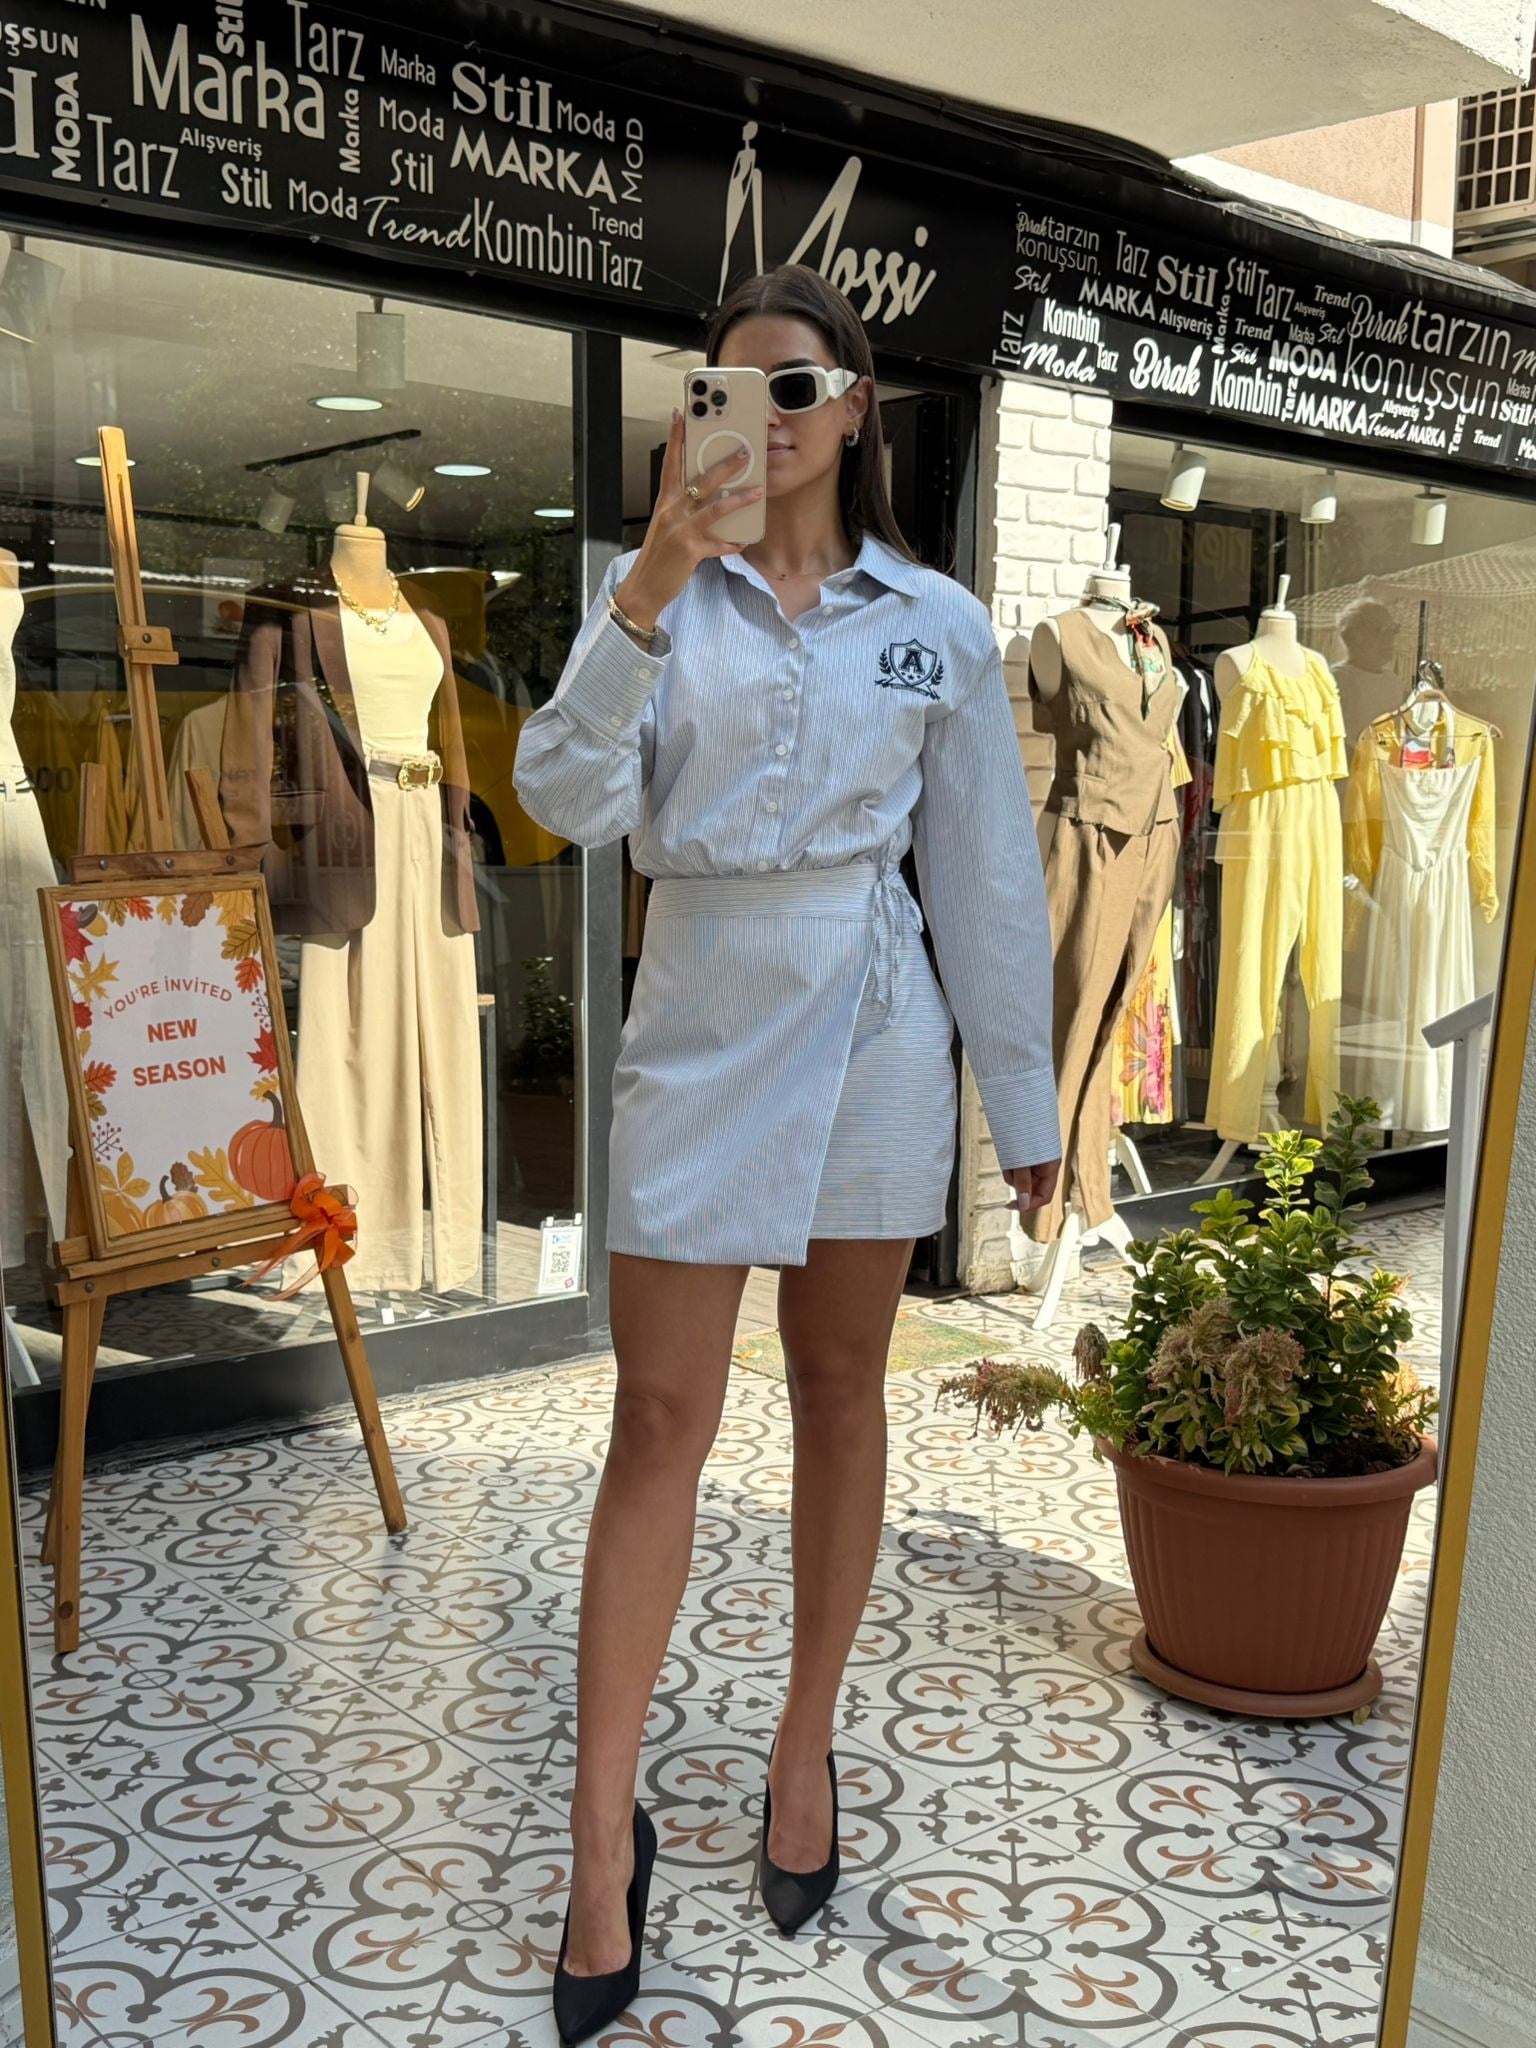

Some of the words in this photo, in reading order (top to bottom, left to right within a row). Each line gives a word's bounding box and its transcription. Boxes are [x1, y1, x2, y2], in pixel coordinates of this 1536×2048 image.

[0, 21, 79, 58] ŞSUN
[287, 0, 365, 82] Tarz
[130, 13, 326, 140] Marka
[381, 45, 436, 86] Marka
[379, 96, 445, 141] Moda
[451, 60, 553, 134] Stil
[51, 72, 82, 182] MODA
[338, 88, 362, 174] Marka
[556, 99, 616, 142] Moda
[87, 113, 180, 199] Tarz
[180, 127, 263, 162] Alışveriş
[450, 124, 618, 205] MARKA
[221, 162, 272, 210] Stil
[390, 148, 434, 196] Stil
[288, 178, 358, 221] Moda
[362, 195, 472, 249] Trend
[473, 197, 594, 281] Kombin
[588, 206, 644, 240] Trend
[716, 121, 937, 325] Mossi
[1046, 216, 1100, 252] tarzın
[598, 240, 644, 291] Tarz
[1116, 229, 1150, 279] Tarz
[1224, 256, 1257, 297] Stil
[1078, 276, 1156, 321] MARKA
[1155, 255, 1219, 308] Stil
[1255, 268, 1295, 323] Tarz
[1314, 284, 1352, 309] Trend
[991, 310, 1025, 367] Tarz
[1042, 297, 1100, 345] Kombin
[1159, 307, 1214, 341] Alışveriş
[1210, 294, 1231, 355] Marka
[1234, 317, 1274, 341] Trend
[1288, 322, 1316, 346] Marka
[1346, 294, 1410, 346] Bırak
[1410, 299, 1511, 370] tarzın
[1021, 341, 1097, 383] Moda
[1096, 341, 1120, 373] Tarz
[1129, 336, 1204, 397] Bırak
[1268, 339, 1337, 384] MODA
[1209, 358, 1283, 419] Kombin
[1280, 376, 1299, 423] Tarz
[1293, 390, 1368, 437] MARKA
[1368, 412, 1409, 440] Trend
[1447, 413, 1467, 455] Tarz
[1499, 399, 1533, 427] Stil
[1406, 423, 1447, 449] MARKA
[1473, 428, 1502, 448] Trend
[899, 648, 925, 675] A
[103, 980, 161, 1020] YOU'RE
[147, 1018, 198, 1043] NEW
[132, 1055, 227, 1088] SEASON
